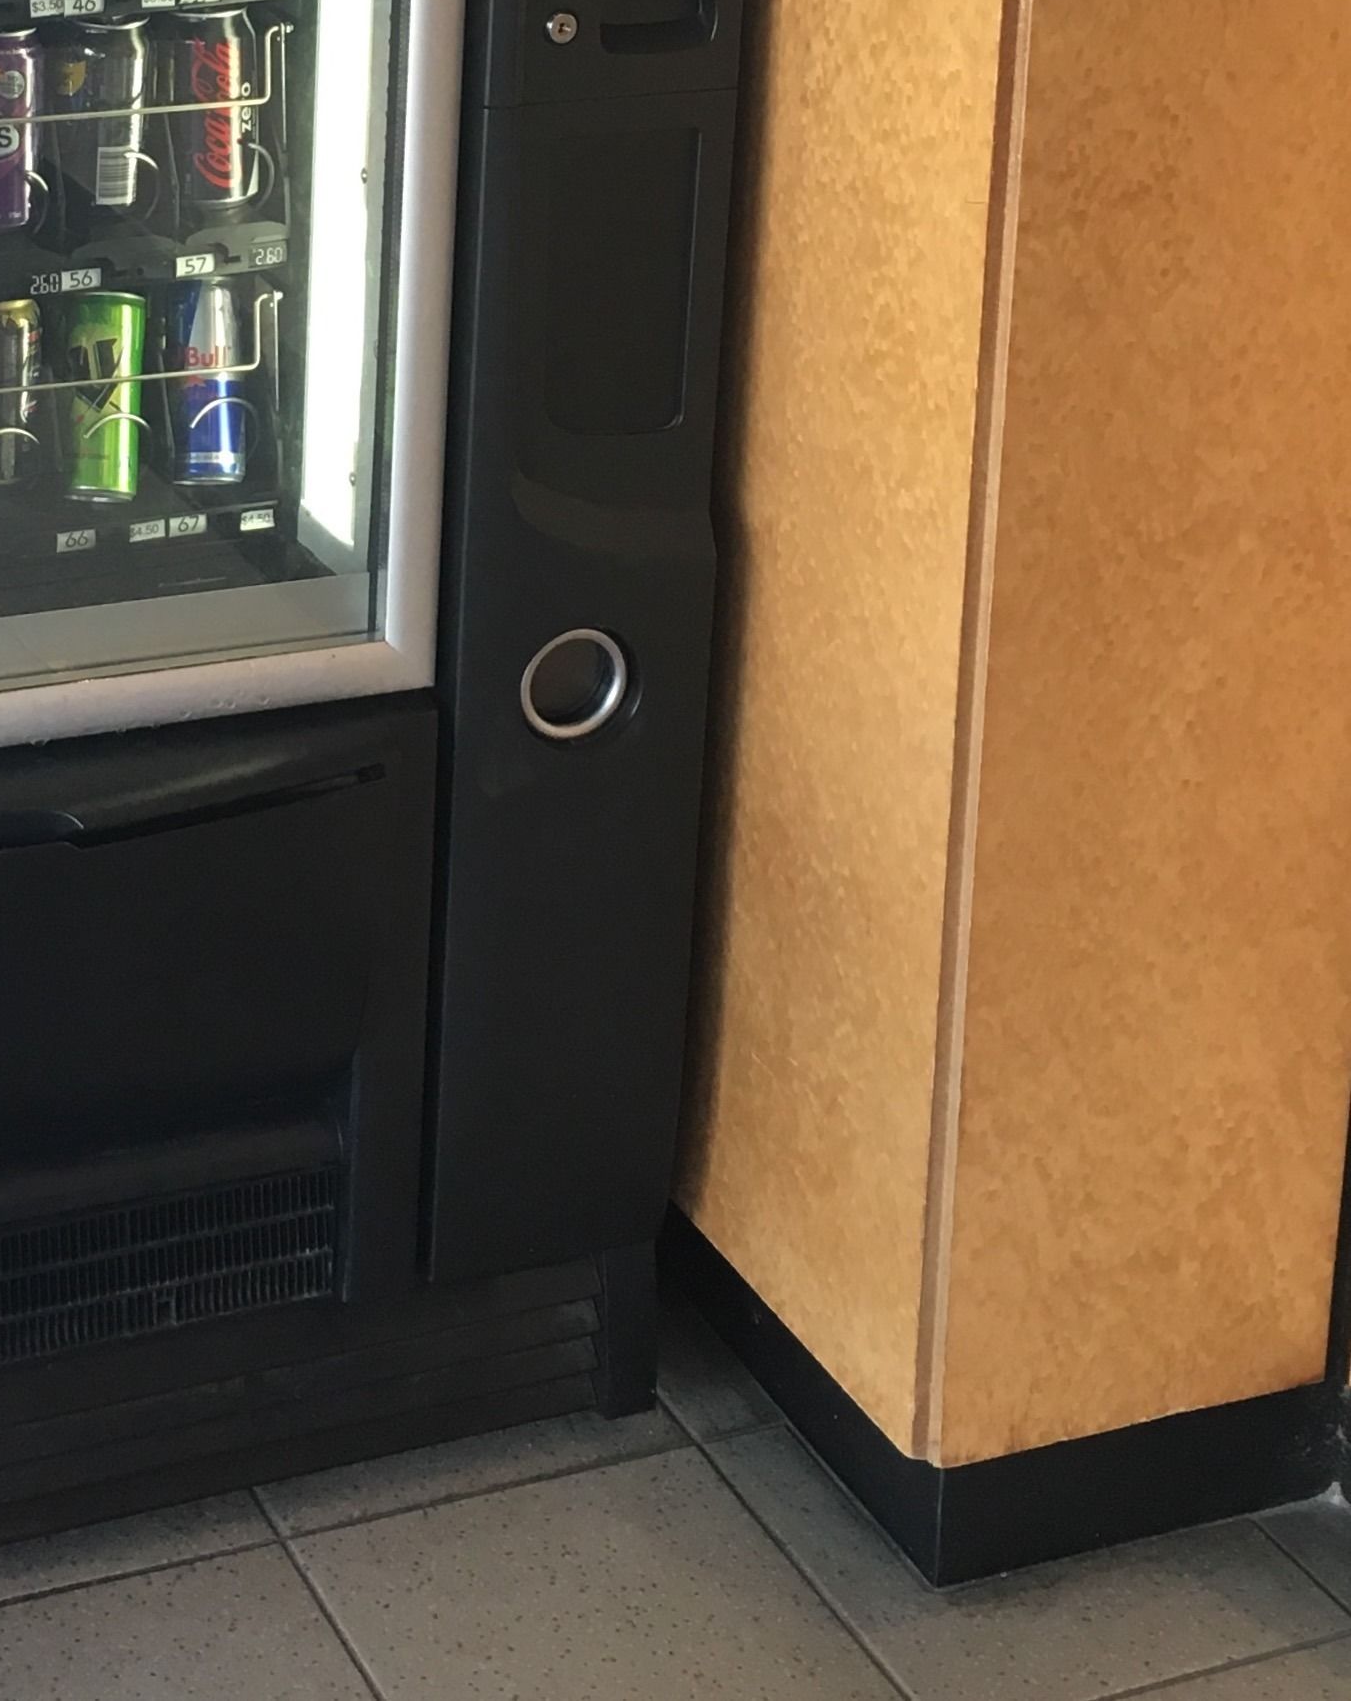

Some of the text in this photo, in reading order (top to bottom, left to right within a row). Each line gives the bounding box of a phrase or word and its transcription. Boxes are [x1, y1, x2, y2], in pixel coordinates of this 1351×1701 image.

[241, 81, 253, 132] zeo
[185, 258, 207, 274] 57
[69, 272, 93, 287] 56
[177, 515, 200, 533] 67
[65, 530, 89, 548] 66
